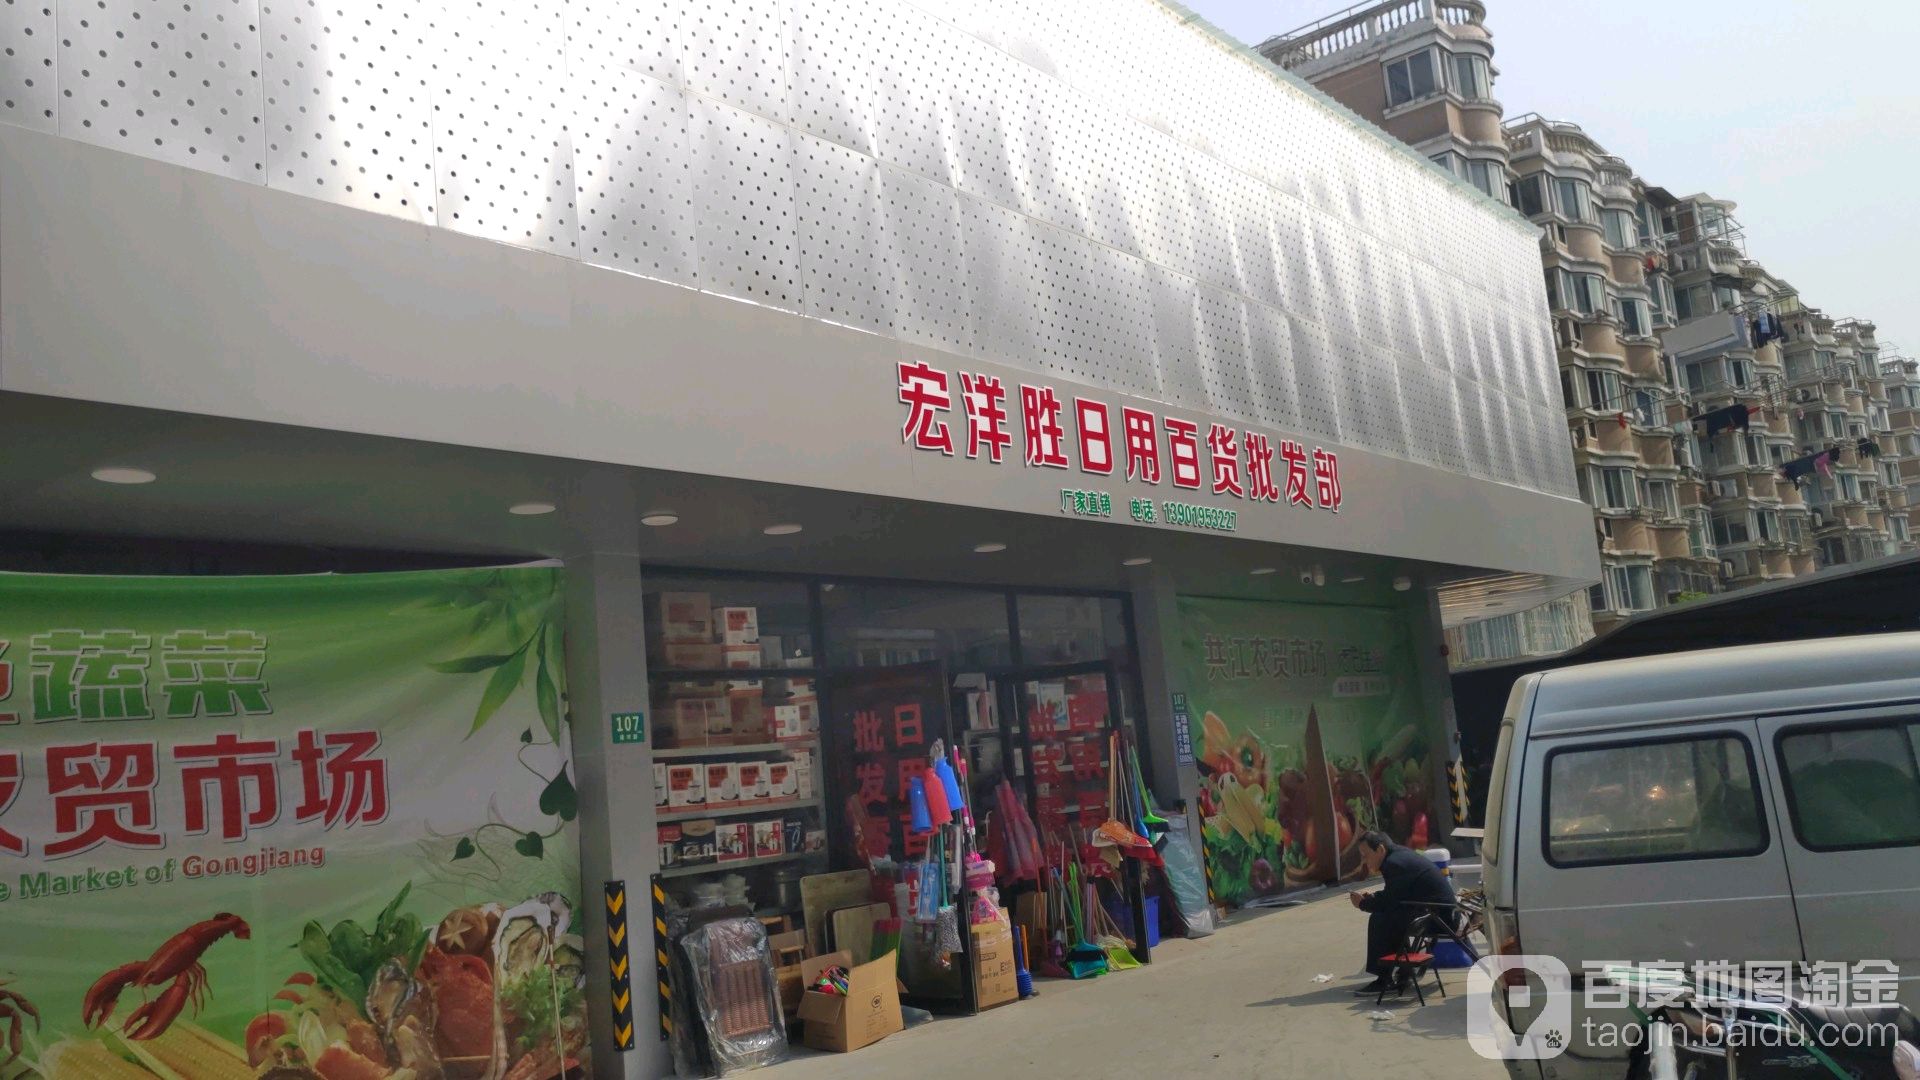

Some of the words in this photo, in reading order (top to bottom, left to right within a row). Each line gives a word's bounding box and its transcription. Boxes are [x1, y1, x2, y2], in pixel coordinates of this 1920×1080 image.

[897, 361, 1343, 512] 宏洋胜日用百货批发部
[1060, 488, 1112, 517] 厂家直销
[1163, 501, 1238, 531] 13901953227
[0, 630, 272, 723] 蔬菜
[1173, 694, 1184, 705] 107
[615, 715, 639, 732] 107
[0, 729, 389, 857] 贸市场
[19, 864, 138, 898] Market
[144, 860, 176, 884] of
[182, 845, 326, 878] Gongjiang
